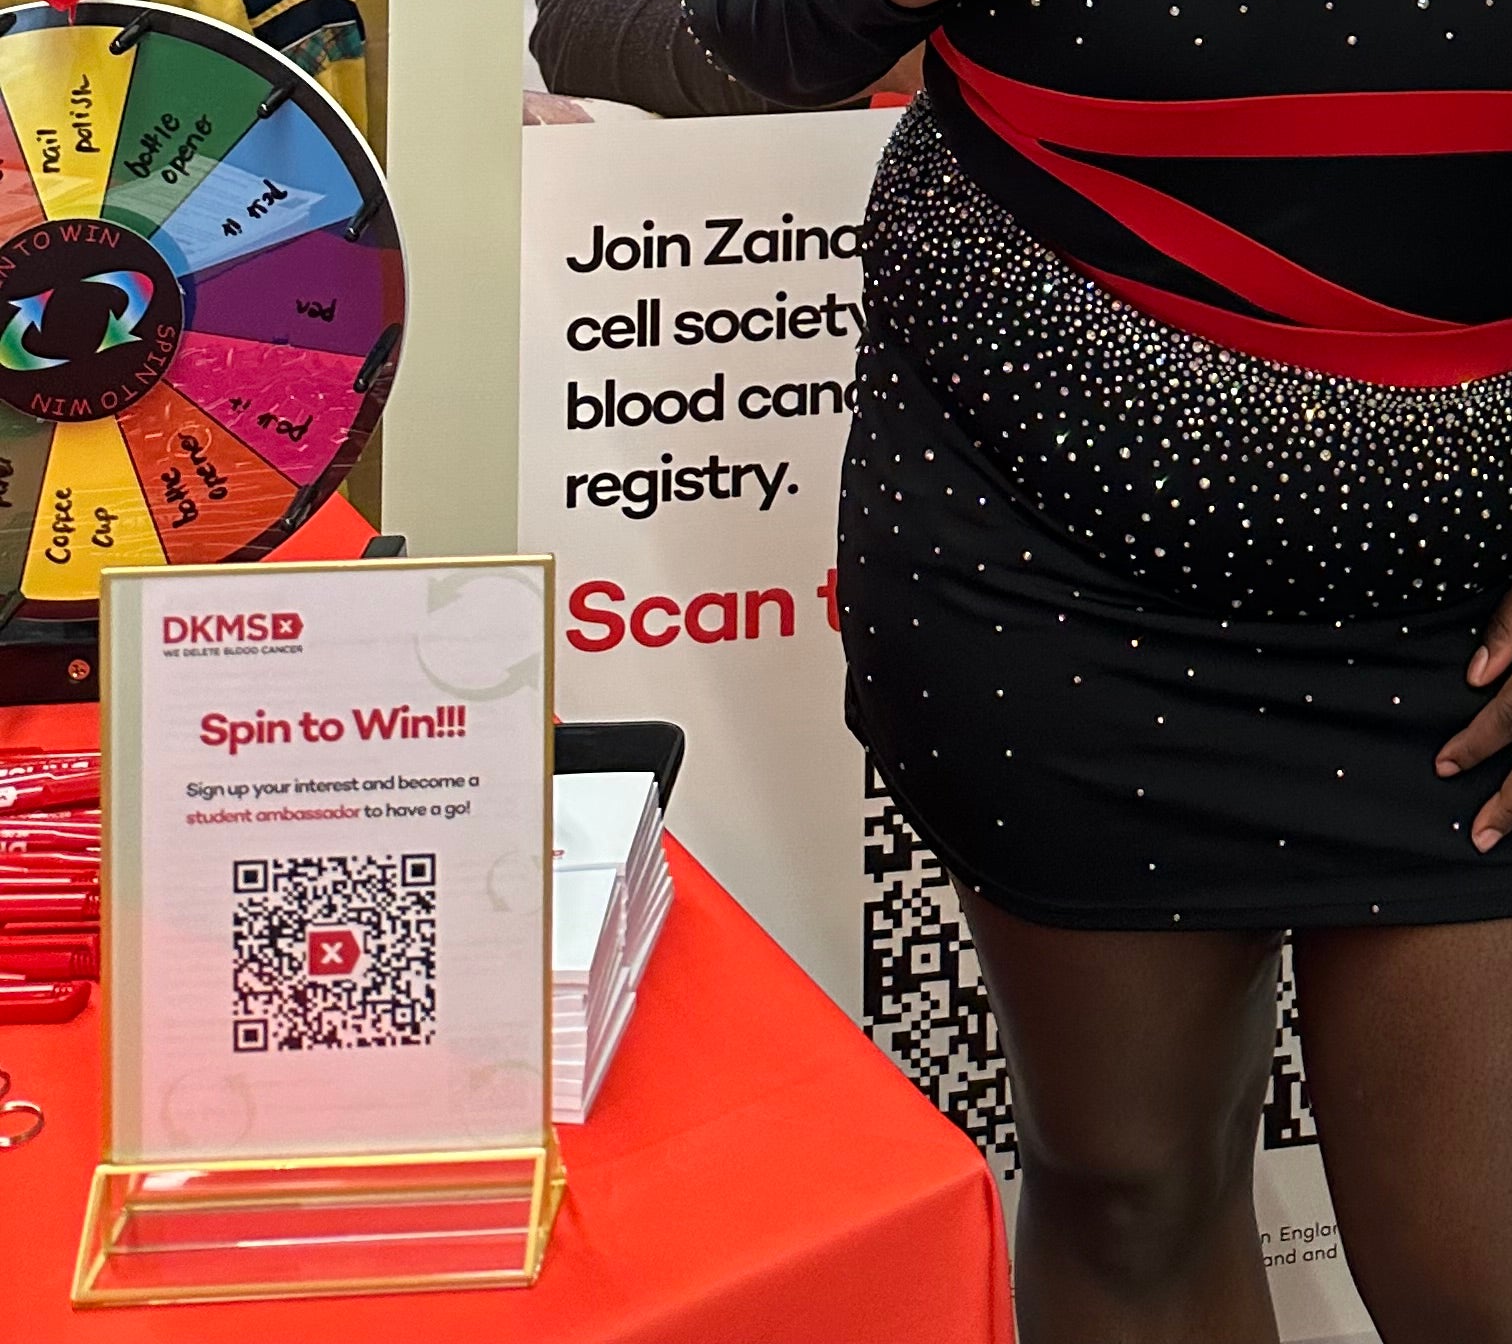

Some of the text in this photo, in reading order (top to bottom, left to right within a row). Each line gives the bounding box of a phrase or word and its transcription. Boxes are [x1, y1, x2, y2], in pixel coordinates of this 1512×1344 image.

[70, 74, 100, 153] polish
[36, 129, 61, 173] nail
[124, 113, 181, 178] bottle
[13, 224, 120, 257] TO WIN
[565, 220, 691, 274] Join
[296, 298, 337, 323] pen
[566, 298, 660, 352] cell
[31, 323, 176, 416] SPIN TO WIN
[566, 373, 723, 430] blood
[566, 454, 798, 519] registry.
[163, 613, 269, 644] DKMS
[565, 580, 795, 652] Scan
[163, 645, 304, 658] WE DELETE BLOOD CANCER
[200, 705, 466, 755] Spin to Win!!!
[187, 774, 480, 801] Sign up your interest and become a
[187, 801, 470, 825] student ambassador to have a go!
[1303, 1243, 1337, 1262] and
